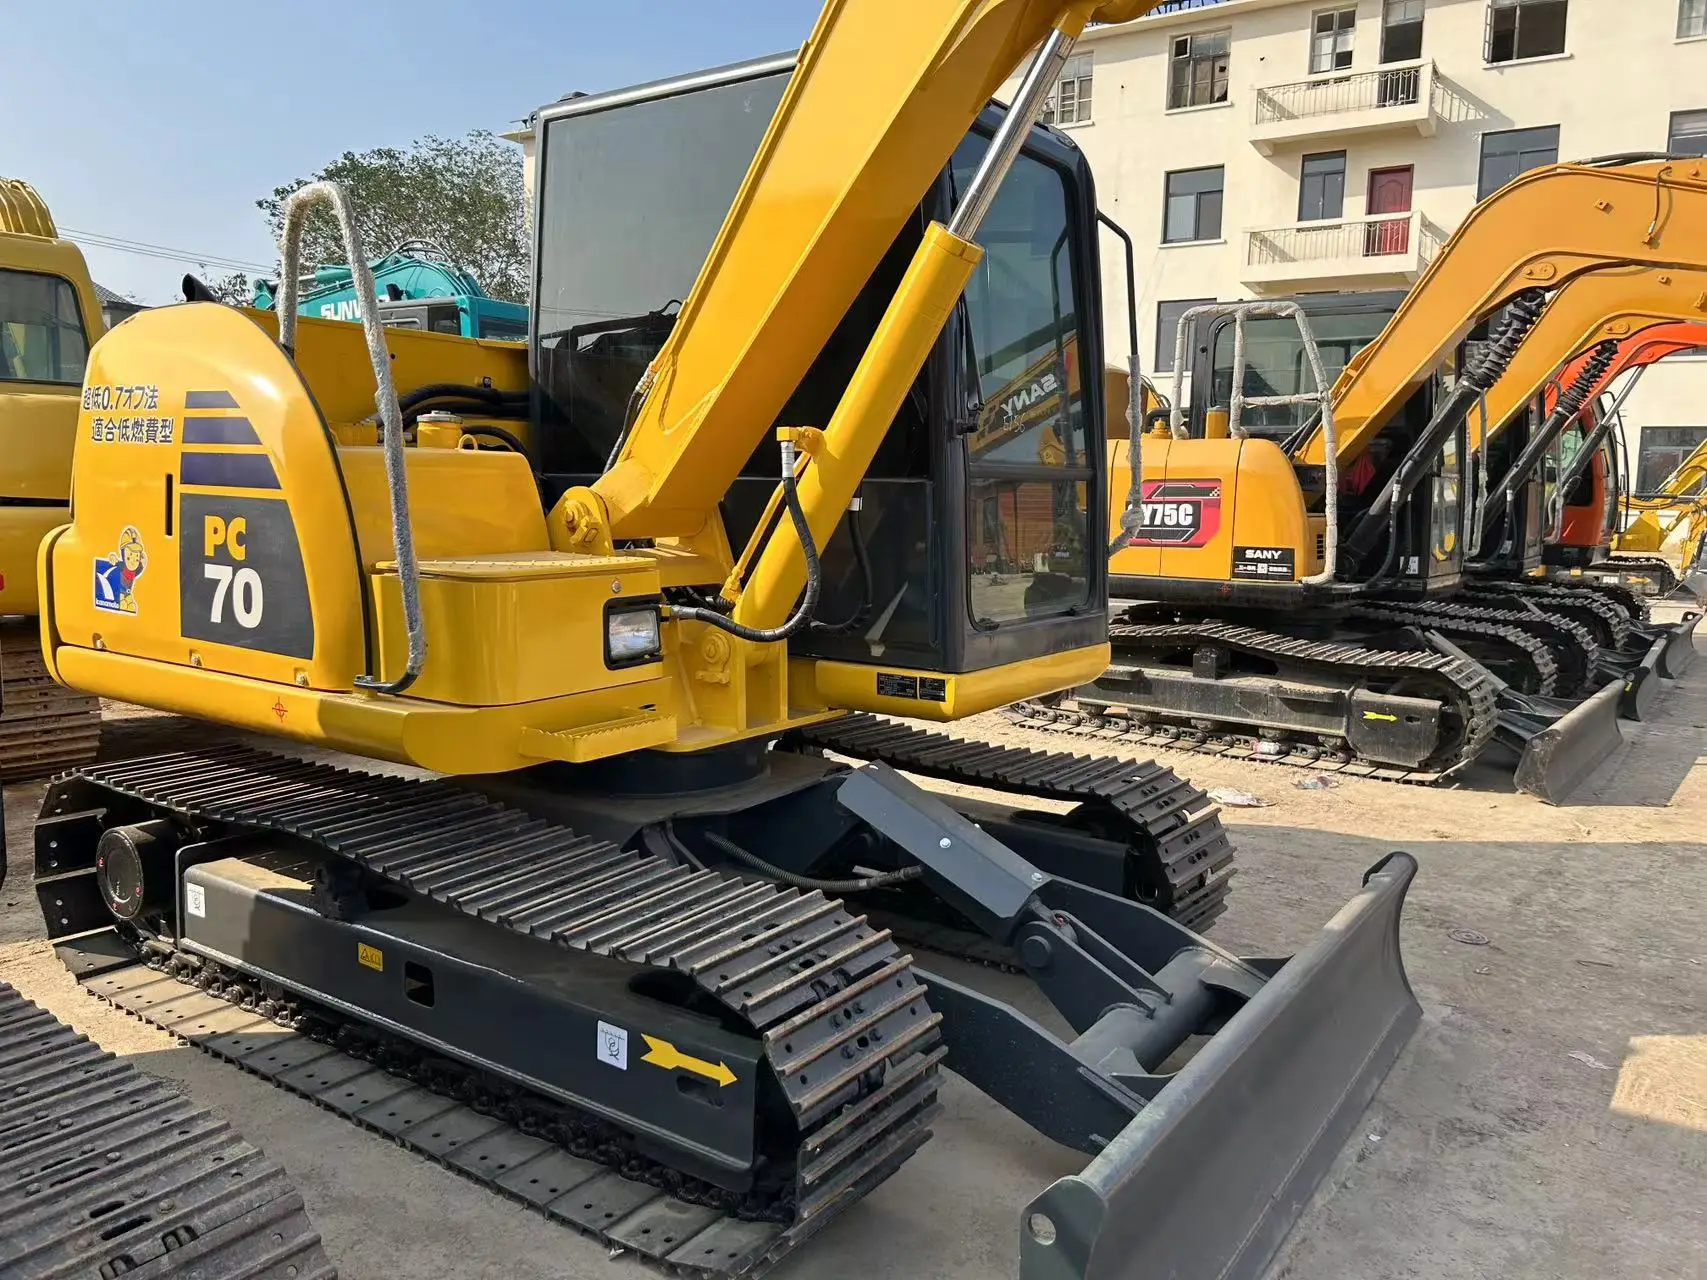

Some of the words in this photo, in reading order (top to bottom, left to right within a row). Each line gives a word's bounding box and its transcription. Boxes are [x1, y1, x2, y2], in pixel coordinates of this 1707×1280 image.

[92, 416, 174, 444] 適合低燃費型
[1129, 503, 1193, 526] Y75C
[204, 515, 247, 560] PC
[1245, 549, 1283, 560] SANY
[204, 563, 264, 629] 70
